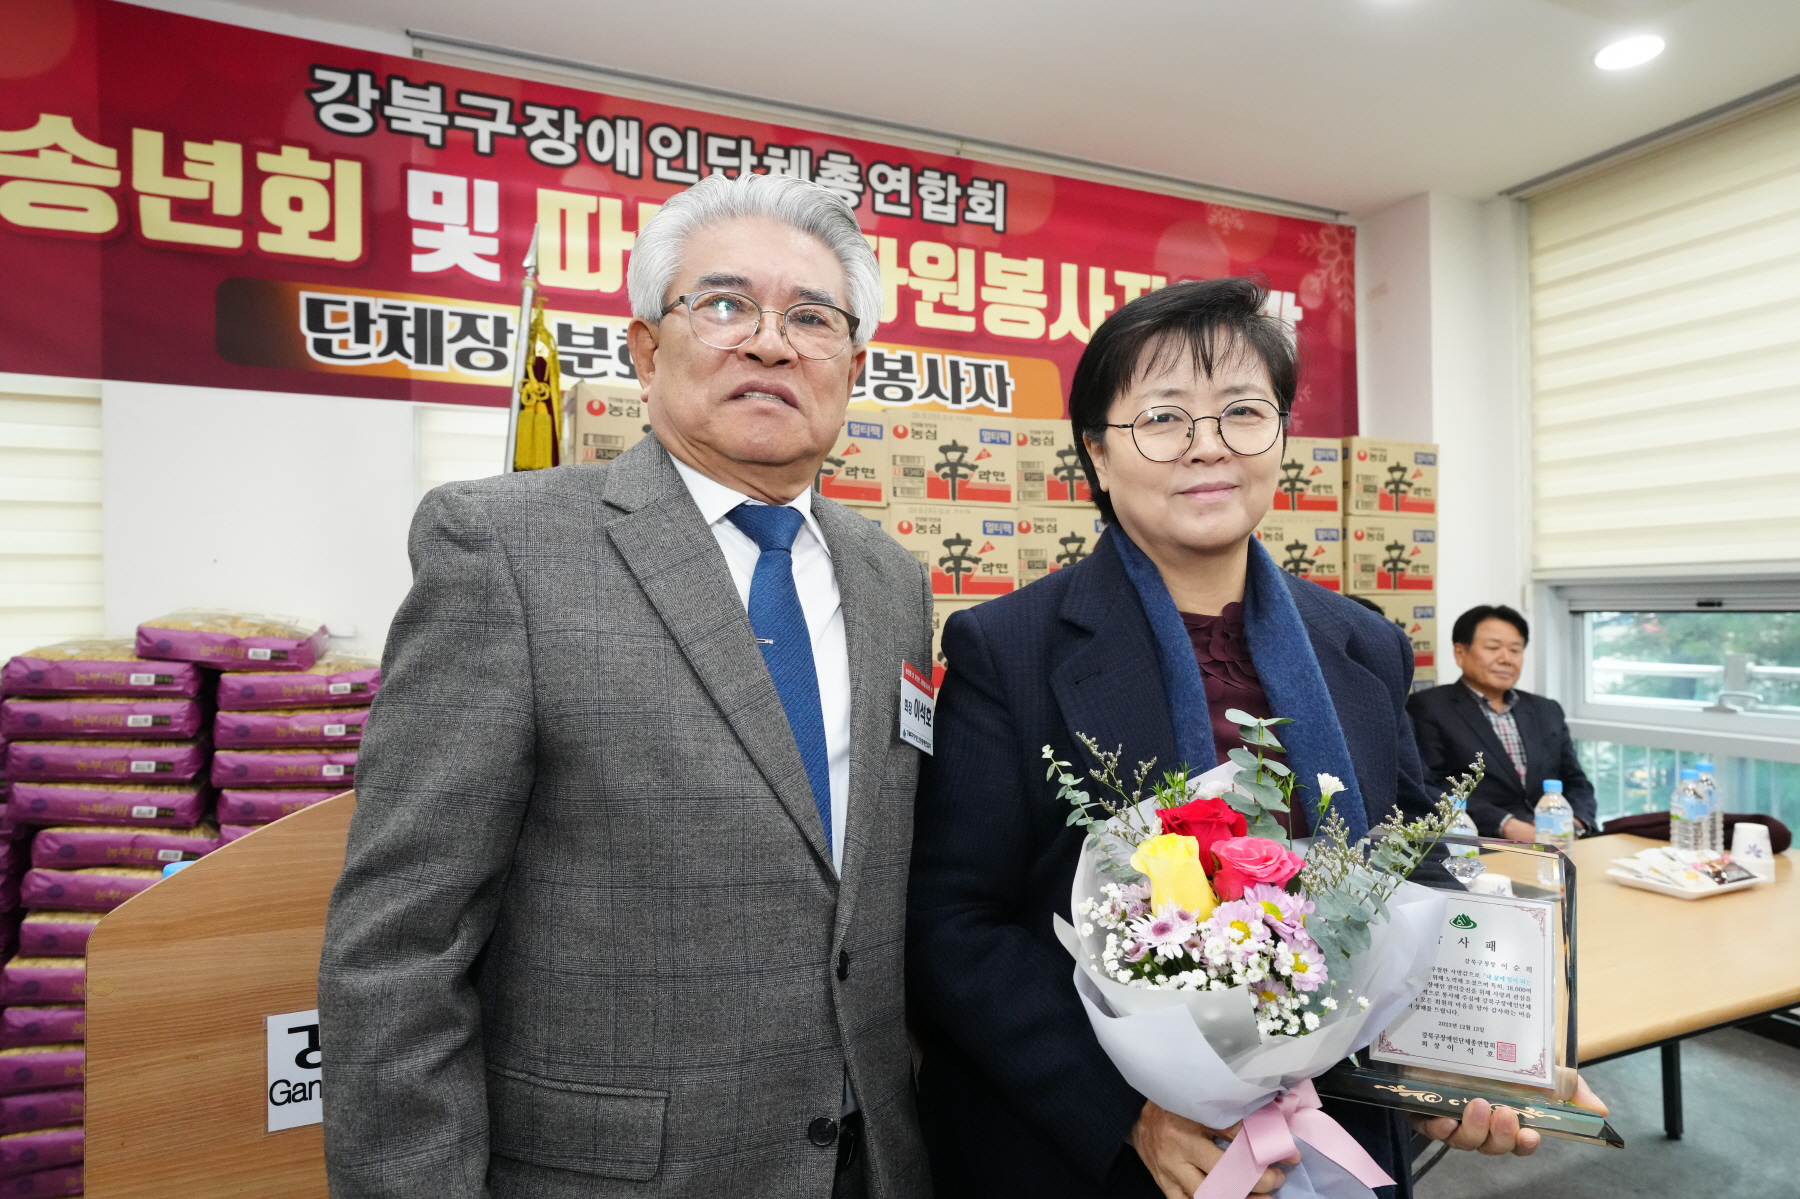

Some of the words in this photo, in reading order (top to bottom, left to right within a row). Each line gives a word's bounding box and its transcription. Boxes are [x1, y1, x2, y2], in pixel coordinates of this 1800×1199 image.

[0, 113, 362, 262] 송년회
[407, 169, 500, 281] 및
[537, 188, 662, 293] 따
[305, 297, 512, 373] 단체장
[556, 322, 638, 380] 분
[851, 352, 1010, 408] 봉사자
[608, 403, 641, 418] 농심
[911, 427, 938, 440] 농심
[1030, 435, 1055, 446] 농심
[845, 466, 875, 480] 라면
[935, 439, 979, 501] 辛
[978, 470, 1005, 482] 라면
[915, 522, 941, 534] 농심
[1033, 523, 1057, 533] 농심
[939, 533, 982, 595] 辛
[982, 562, 1009, 575] 라면
